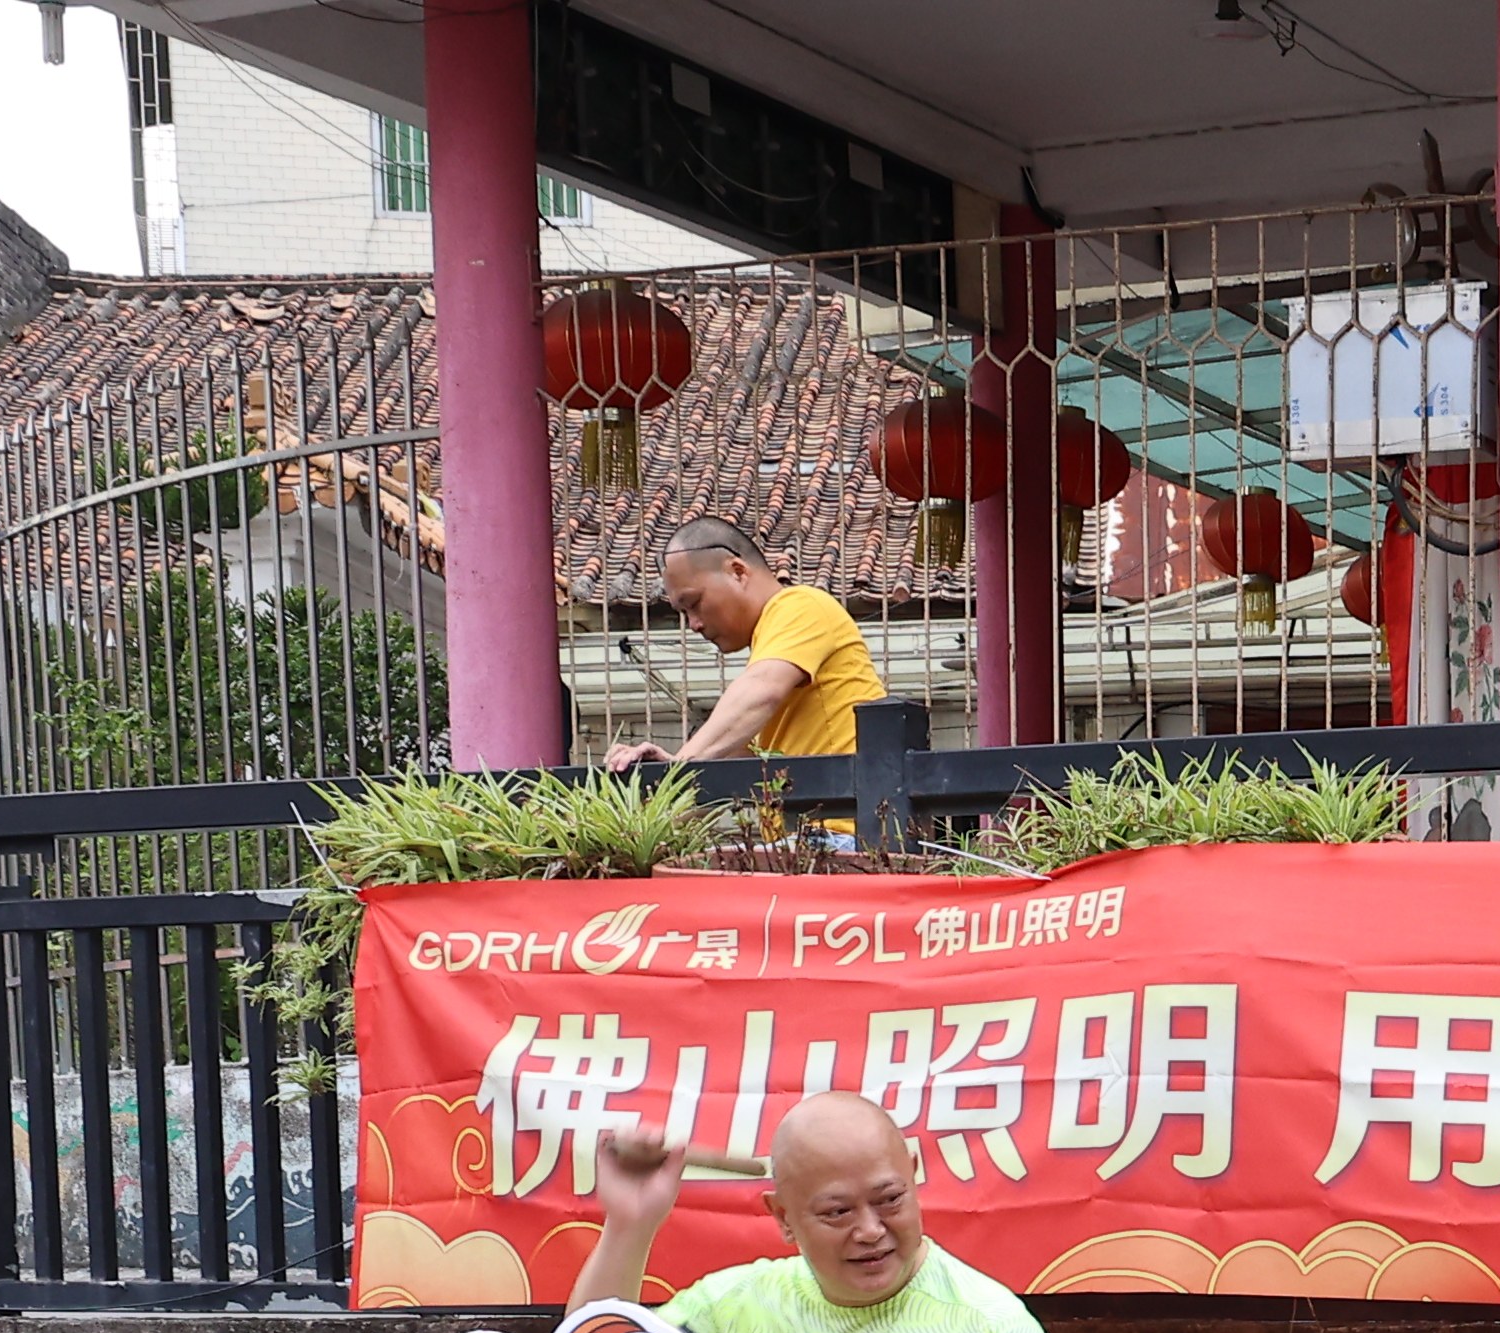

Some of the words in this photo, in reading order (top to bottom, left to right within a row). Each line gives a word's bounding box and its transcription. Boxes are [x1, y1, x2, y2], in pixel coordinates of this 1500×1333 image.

[792, 909, 906, 968] FSL
[914, 884, 1127, 964] 佛山照明
[475, 982, 1237, 1199] 佛山照明
